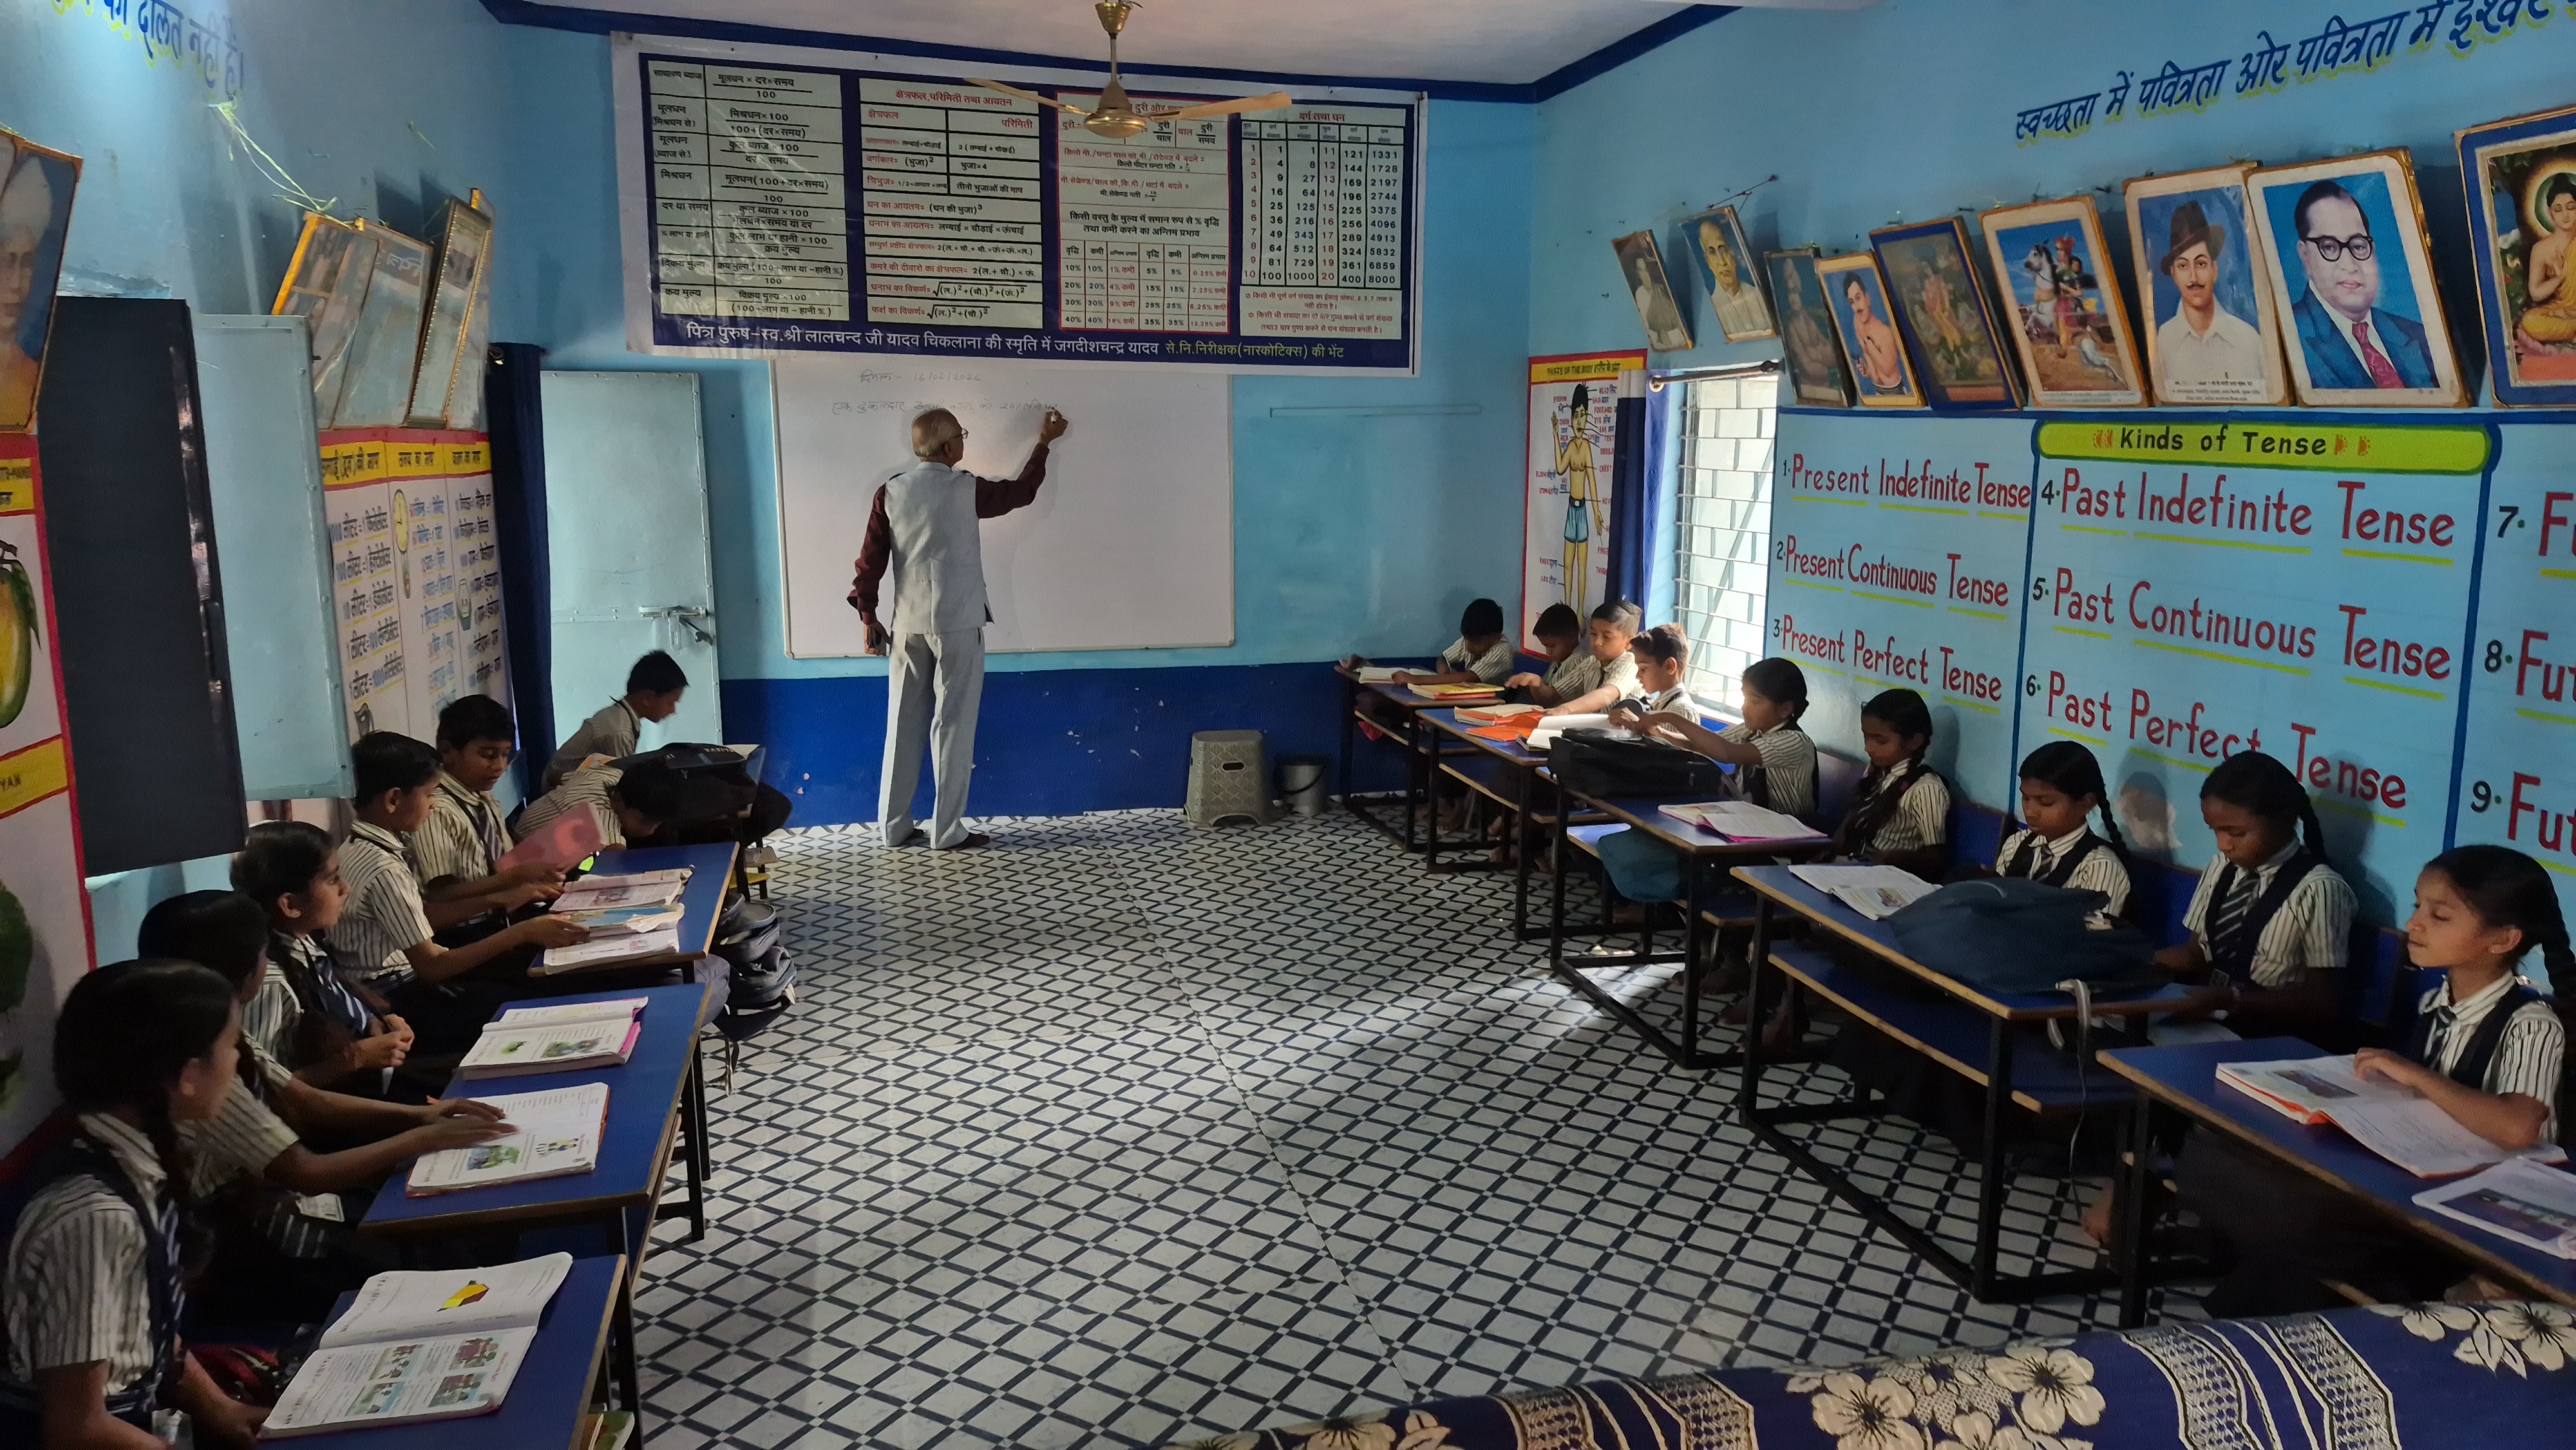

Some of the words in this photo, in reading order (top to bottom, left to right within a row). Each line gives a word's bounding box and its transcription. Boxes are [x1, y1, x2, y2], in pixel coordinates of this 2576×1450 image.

[2107, 71, 2134, 115] में
[2139, 60, 2231, 112] पवित्रता
[2297, 15, 2410, 76] पवित्रता
[983, 97, 1012, 106] आयतन
[764, 194, 783, 203] 100
[1149, 216, 1169, 224] समान
[1102, 225, 1117, 234] कमी
[1120, 225, 1137, 234] करने
[1370, 220, 1396, 229] 4096
[804, 330, 862, 346] लालचन्द
[866, 332, 882, 346] जी
[887, 333, 919, 348] यादव
[923, 332, 981, 350] चिकलाना
[985, 334, 1002, 350] की
[1005, 337, 1037, 353] स्मृति
[1041, 335, 1052, 352] में
[1128, 341, 1159, 355] यादव
[1312, 344, 1325, 358] की
[1329, 344, 1344, 358] भेंट
[2120, 426, 2184, 451] Kinds
[2200, 423, 2229, 452] of
[2242, 431, 2327, 456] Tense
[1792, 453, 1870, 495] Present
[1879, 458, 1971, 504] Indefinite
[1975, 462, 2031, 509] Tense
[2061, 467, 2126, 518] Past
[2136, 471, 2313, 536] Indefinite
[2336, 480, 2456, 547] Tense
[1785, 534, 1845, 580] Present
[1847, 543, 1938, 595] Continuous
[1947, 553, 2009, 607] Tense
[2053, 567, 2115, 626] Past
[2128, 580, 2316, 659] Continuous
[2338, 604, 2452, 681] Tense
[1782, 614, 1846, 664] Present
[1853, 628, 1929, 685] Perfect
[1939, 646, 2002, 702] Tense
[2047, 670, 2113, 733] Past
[2128, 686, 2262, 764] Perfect
[2290, 721, 2407, 810] Tense
